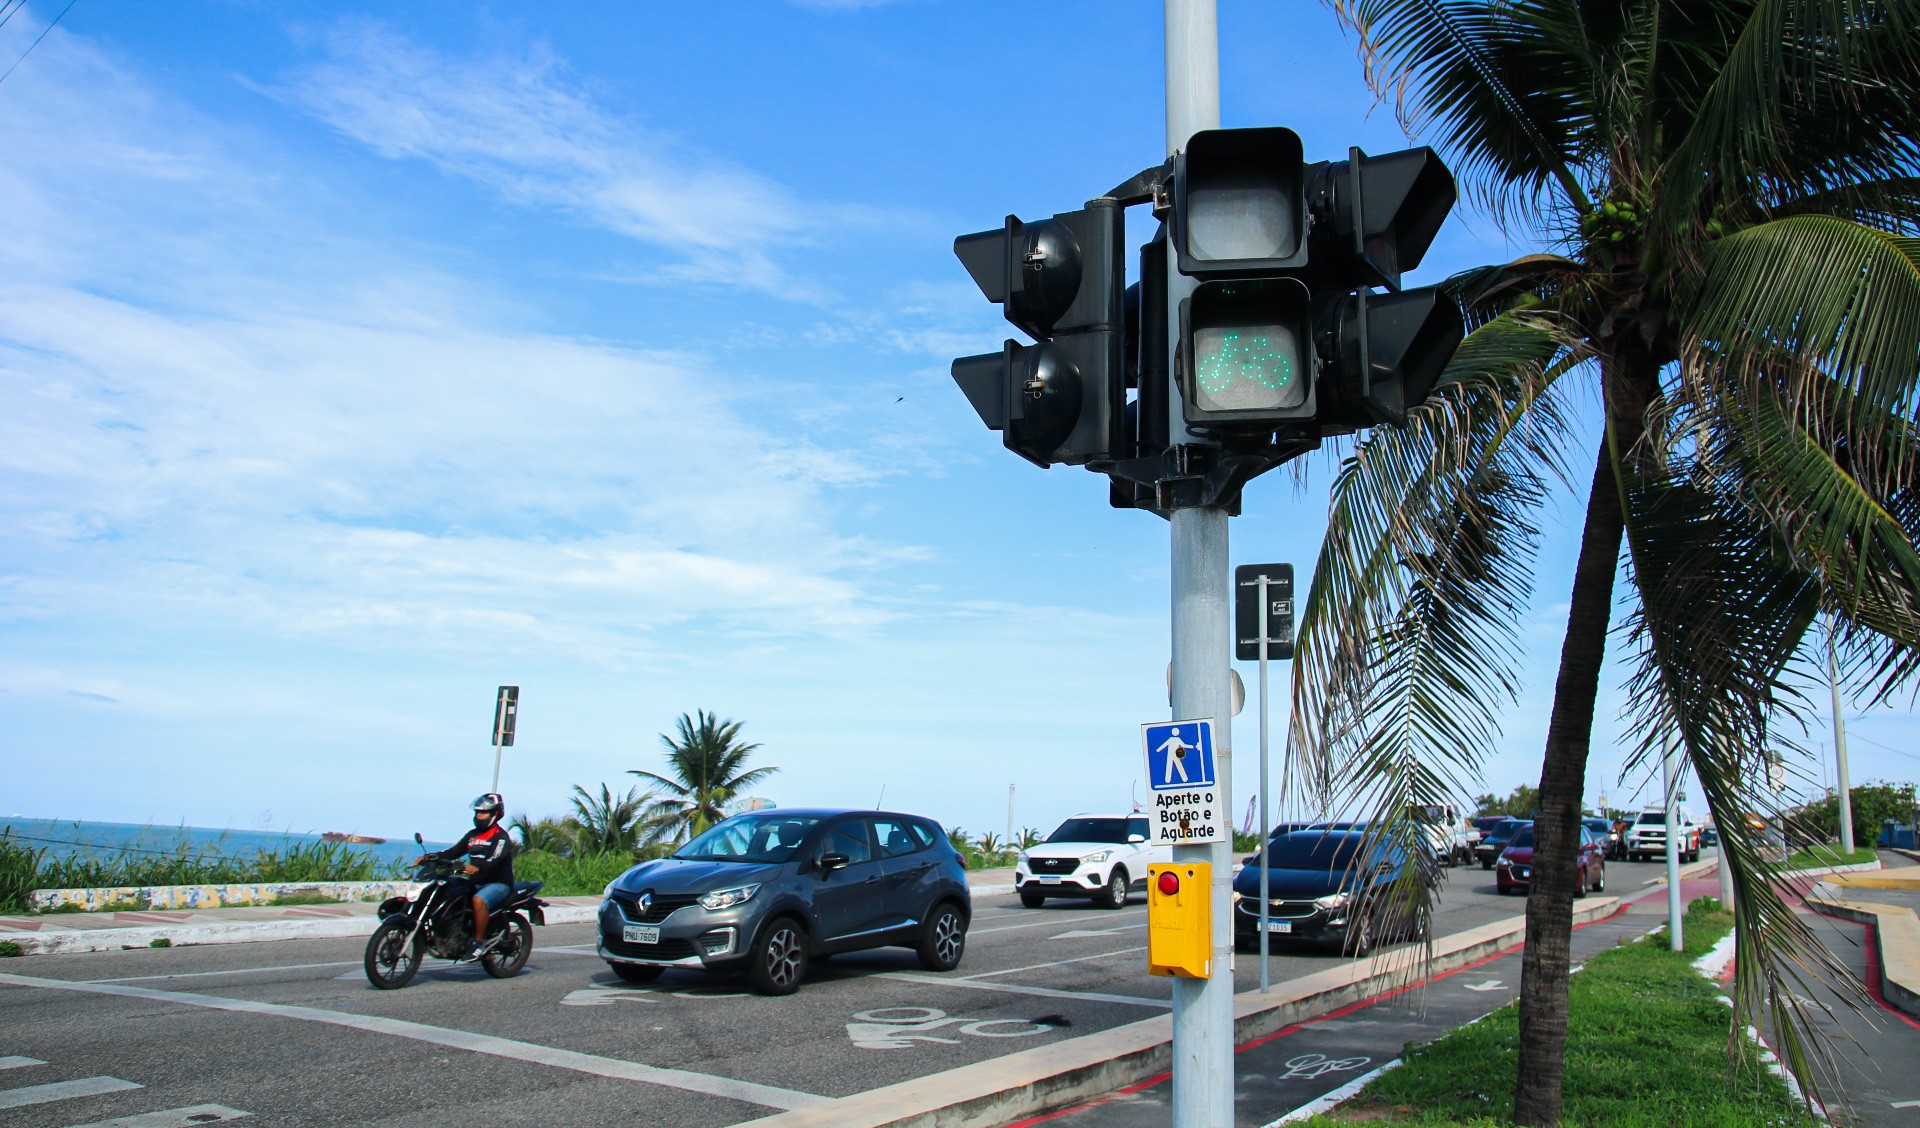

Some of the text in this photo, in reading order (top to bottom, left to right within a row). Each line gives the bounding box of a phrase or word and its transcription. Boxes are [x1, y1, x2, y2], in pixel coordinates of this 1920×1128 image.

[1156, 792, 1213, 809] Aperte o
[1160, 808, 1212, 823] Botão e
[1160, 824, 1215, 842] Aguarde
